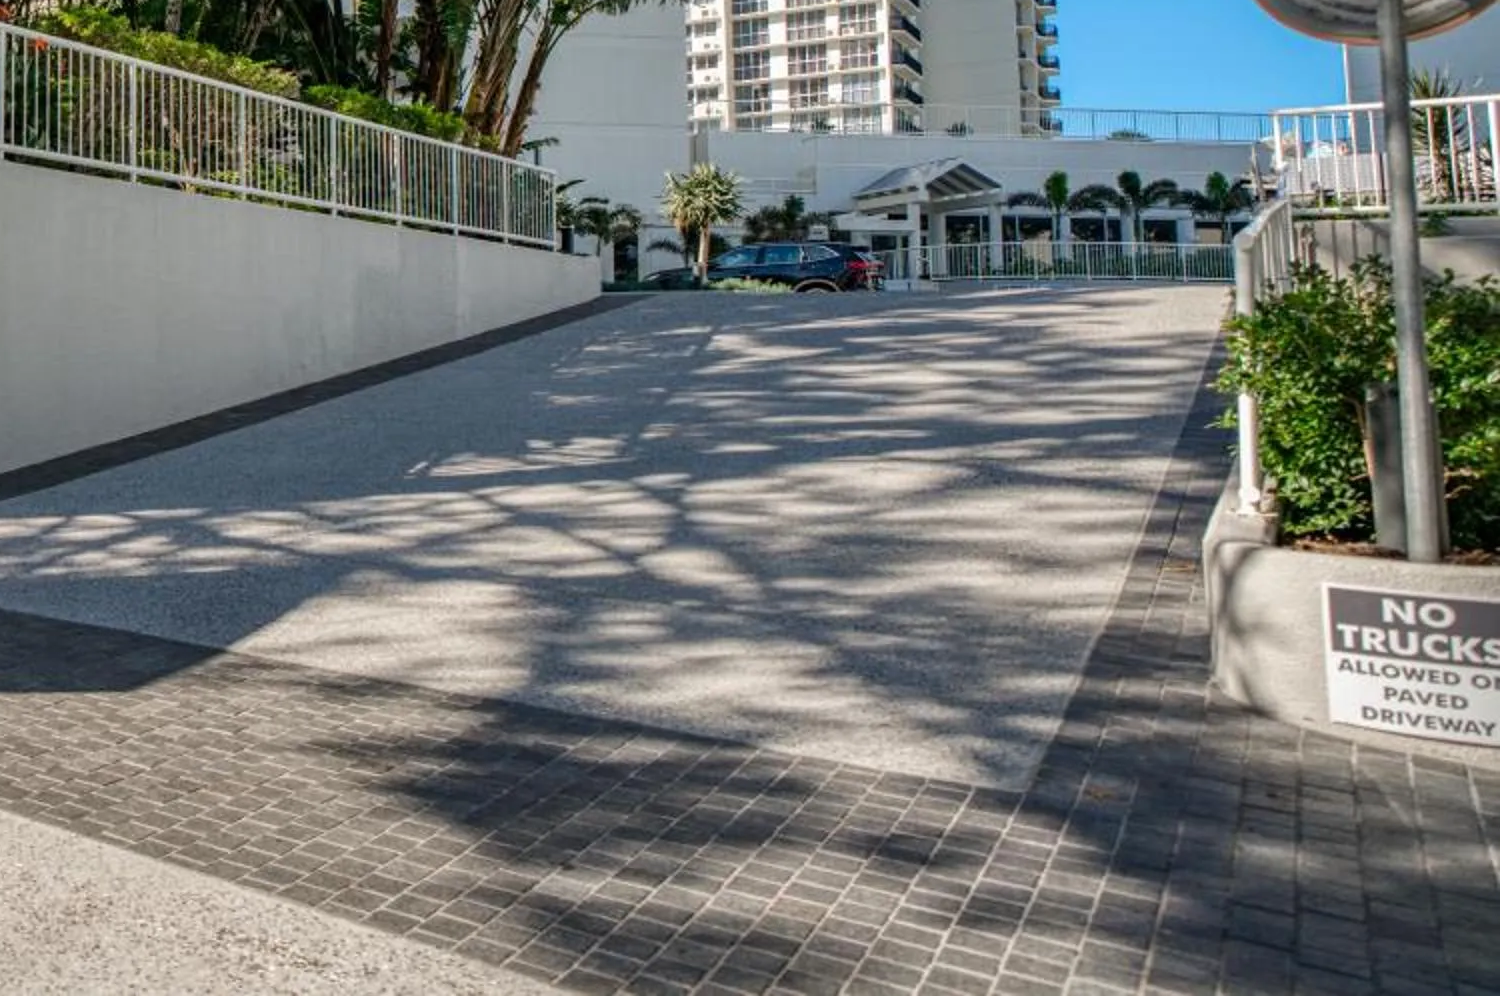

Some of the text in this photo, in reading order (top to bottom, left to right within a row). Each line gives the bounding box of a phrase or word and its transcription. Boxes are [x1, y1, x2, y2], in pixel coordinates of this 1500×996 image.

[1381, 597, 1457, 629] NO
[1336, 623, 1500, 667] TRUCKS
[1338, 657, 1462, 686] ALLOWED
[1383, 686, 1469, 710] PAVED
[1361, 705, 1497, 738] DRIVEWAY
